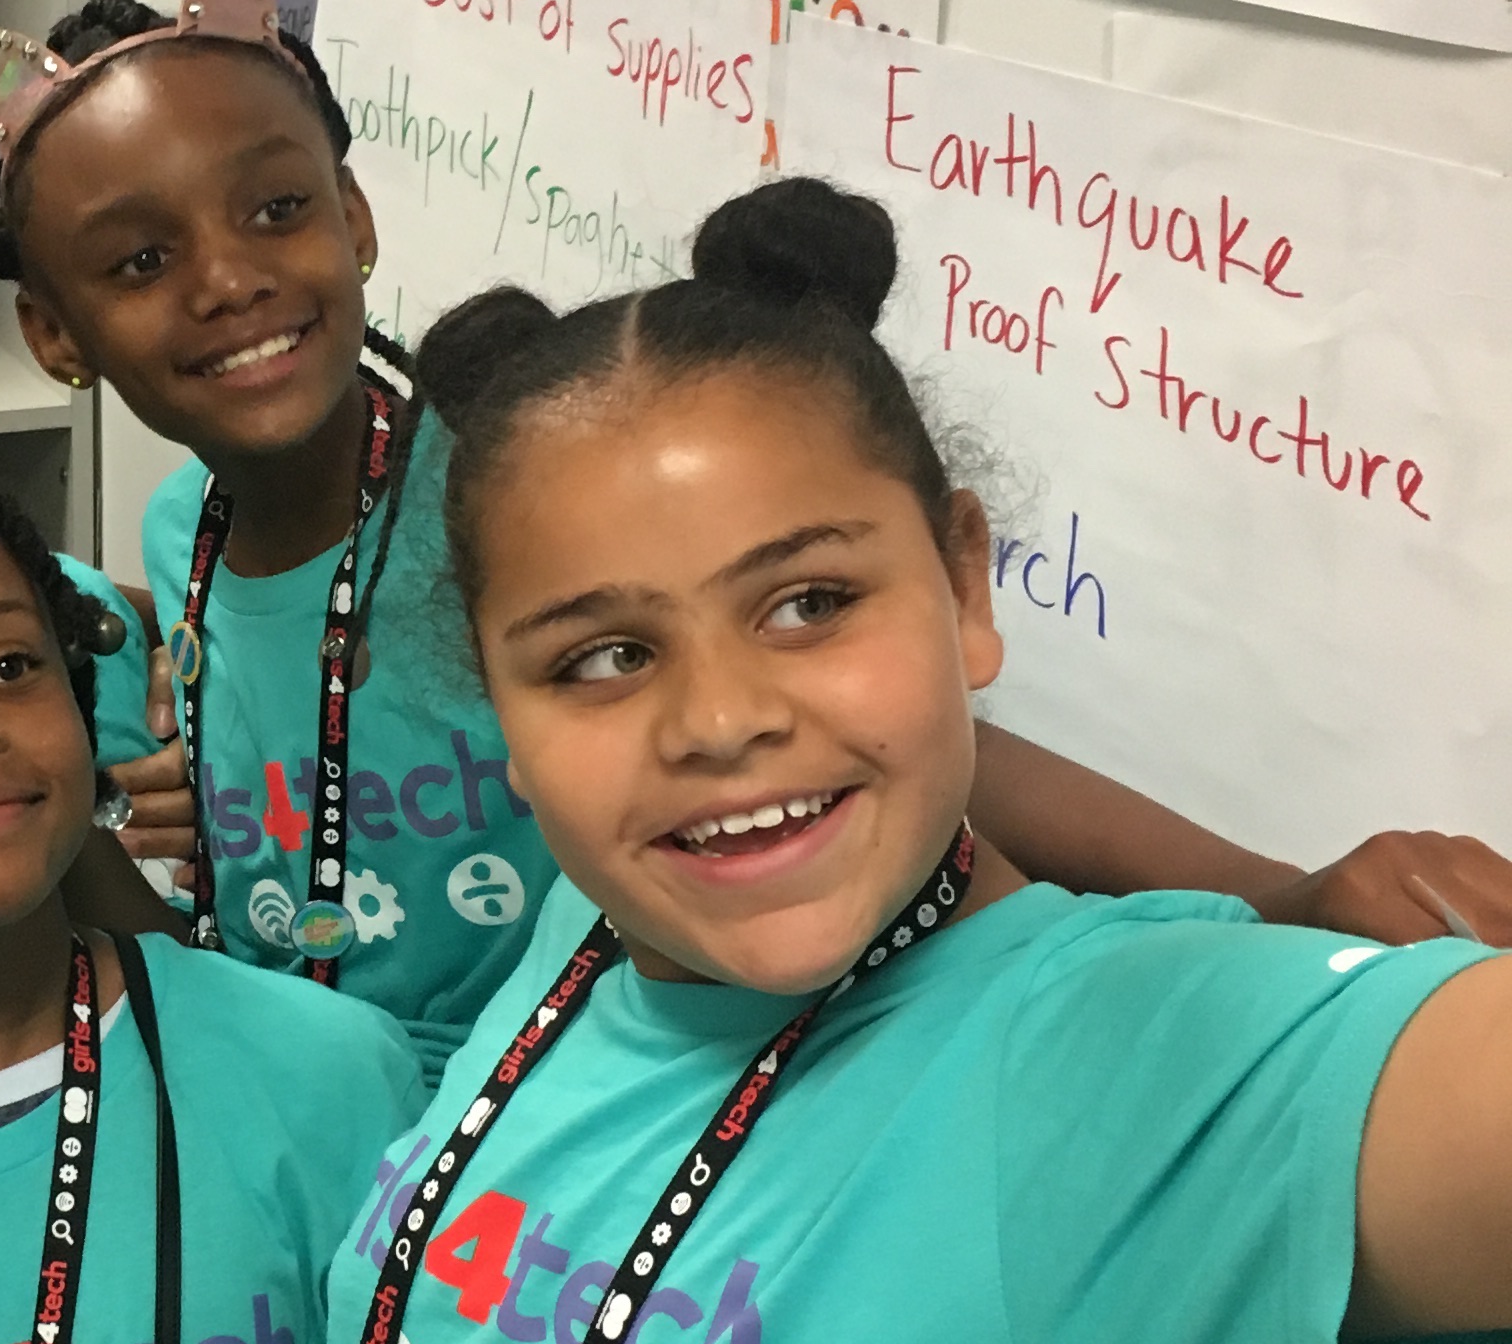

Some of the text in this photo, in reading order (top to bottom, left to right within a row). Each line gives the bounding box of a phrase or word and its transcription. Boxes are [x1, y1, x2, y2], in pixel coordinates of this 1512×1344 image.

[884, 64, 1305, 315] Earthquake
[940, 253, 1065, 376] Proof
[67, 953, 97, 1073] girls4tech
[497, 948, 602, 1085] girls4tech
